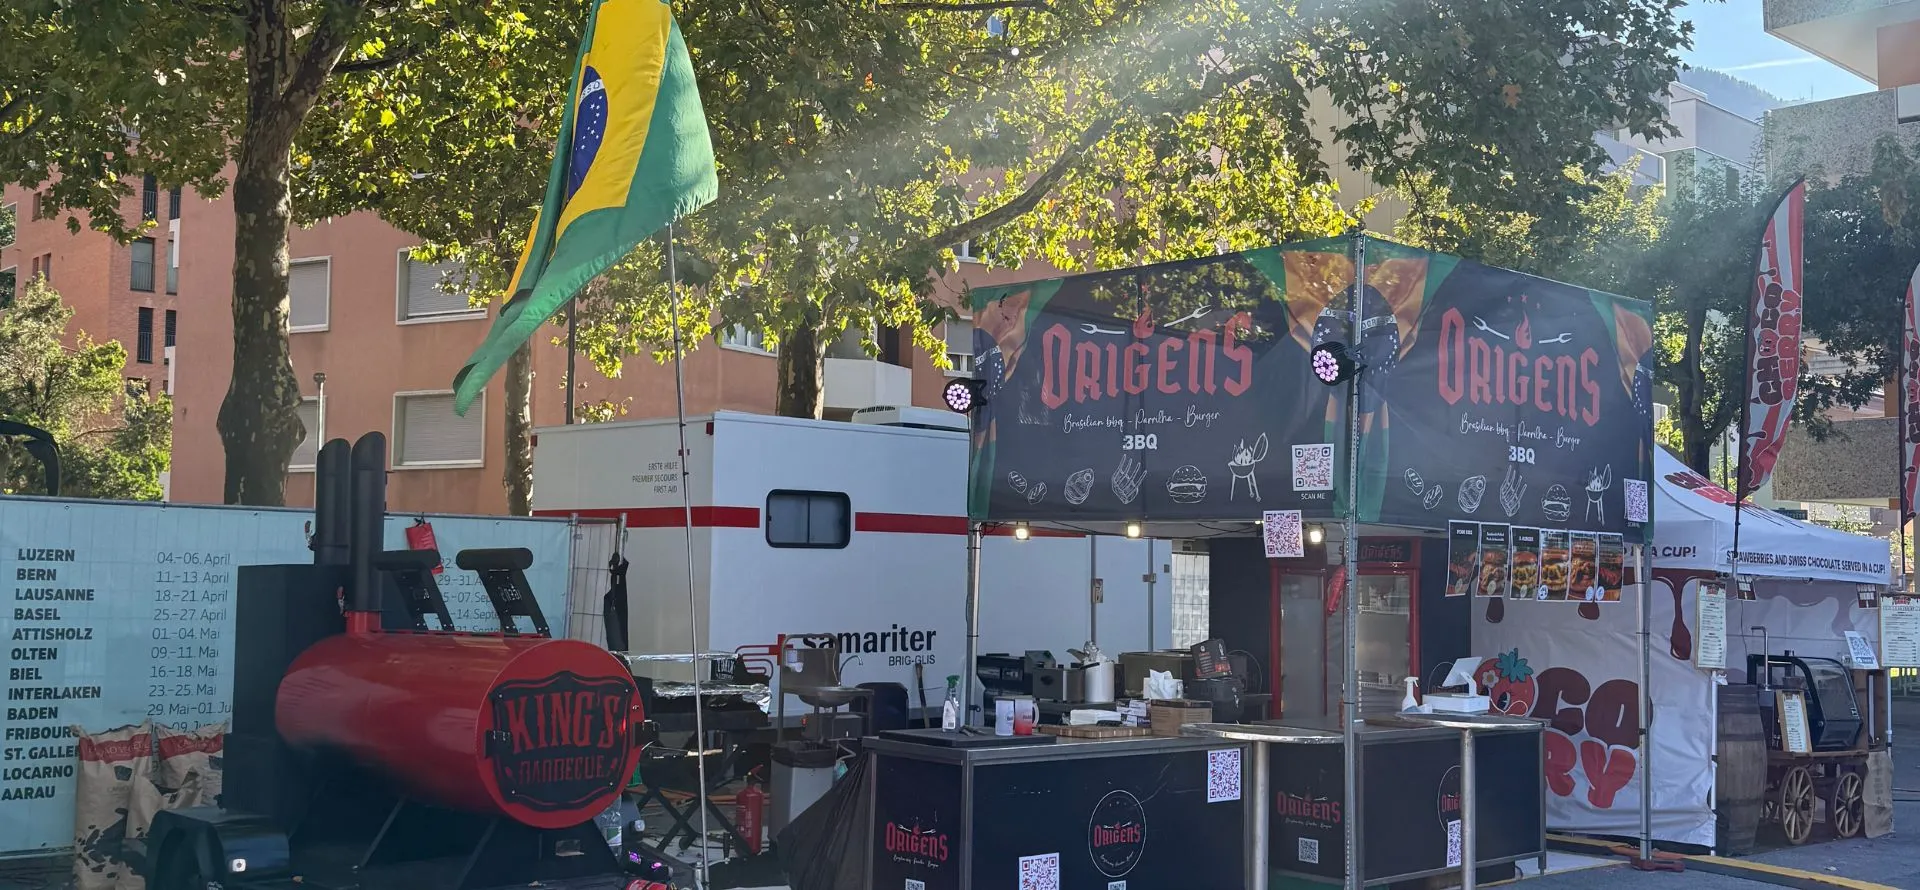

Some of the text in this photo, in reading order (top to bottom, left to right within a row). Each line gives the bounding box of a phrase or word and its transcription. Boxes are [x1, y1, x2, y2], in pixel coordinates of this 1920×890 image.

[1041, 311, 1253, 409] ORIGENS
[1438, 307, 1599, 427] ORIGENS
[1184, 404, 1220, 428] Burger
[648, 462, 662, 470] ERSTE
[654, 473, 678, 482] SECOURS
[18, 549, 75, 561] LUZERN
[1662, 546, 1697, 557] CUP!
[204, 553, 230, 567] April
[1726, 550, 1774, 565] STAWBERRIES
[1774, 555, 1788, 566] AND
[1788, 555, 1807, 567] SWISS
[1808, 556, 1841, 571] CHOCOLATE
[1841, 560, 1862, 572] SERVED
[1873, 563, 1886, 574] CUP!
[16, 568, 57, 581] BERN
[202, 572, 229, 587] April
[15, 588, 95, 600] LAUSANNE
[201, 590, 227, 605] April
[14, 608, 60, 620] BASEL
[200, 609, 226, 624] April
[12, 628, 93, 640] ATTISHOLZ
[200, 628, 220, 640] Mai
[803, 624, 936, 653] samariter
[11, 648, 57, 660] OLTEN
[198, 646, 219, 658] Mai
[889, 655, 936, 666] BRIG-GLIS
[10, 668, 42, 680] BIEL
[197, 665, 218, 677] Mai
[8, 686, 101, 700] INTERLAKEN
[196, 684, 216, 696] Mai
[7, 707, 58, 720] BADEN
[506, 691, 620, 754] KING'S
[4, 747, 26, 760] ST.
[3, 765, 74, 780] LOCARNO
[518, 756, 605, 784] BARBECUE
[2, 786, 55, 800] AARAU
[885, 822, 949, 861] ORIGENS
[1094, 823, 1141, 848] ORIGENS
